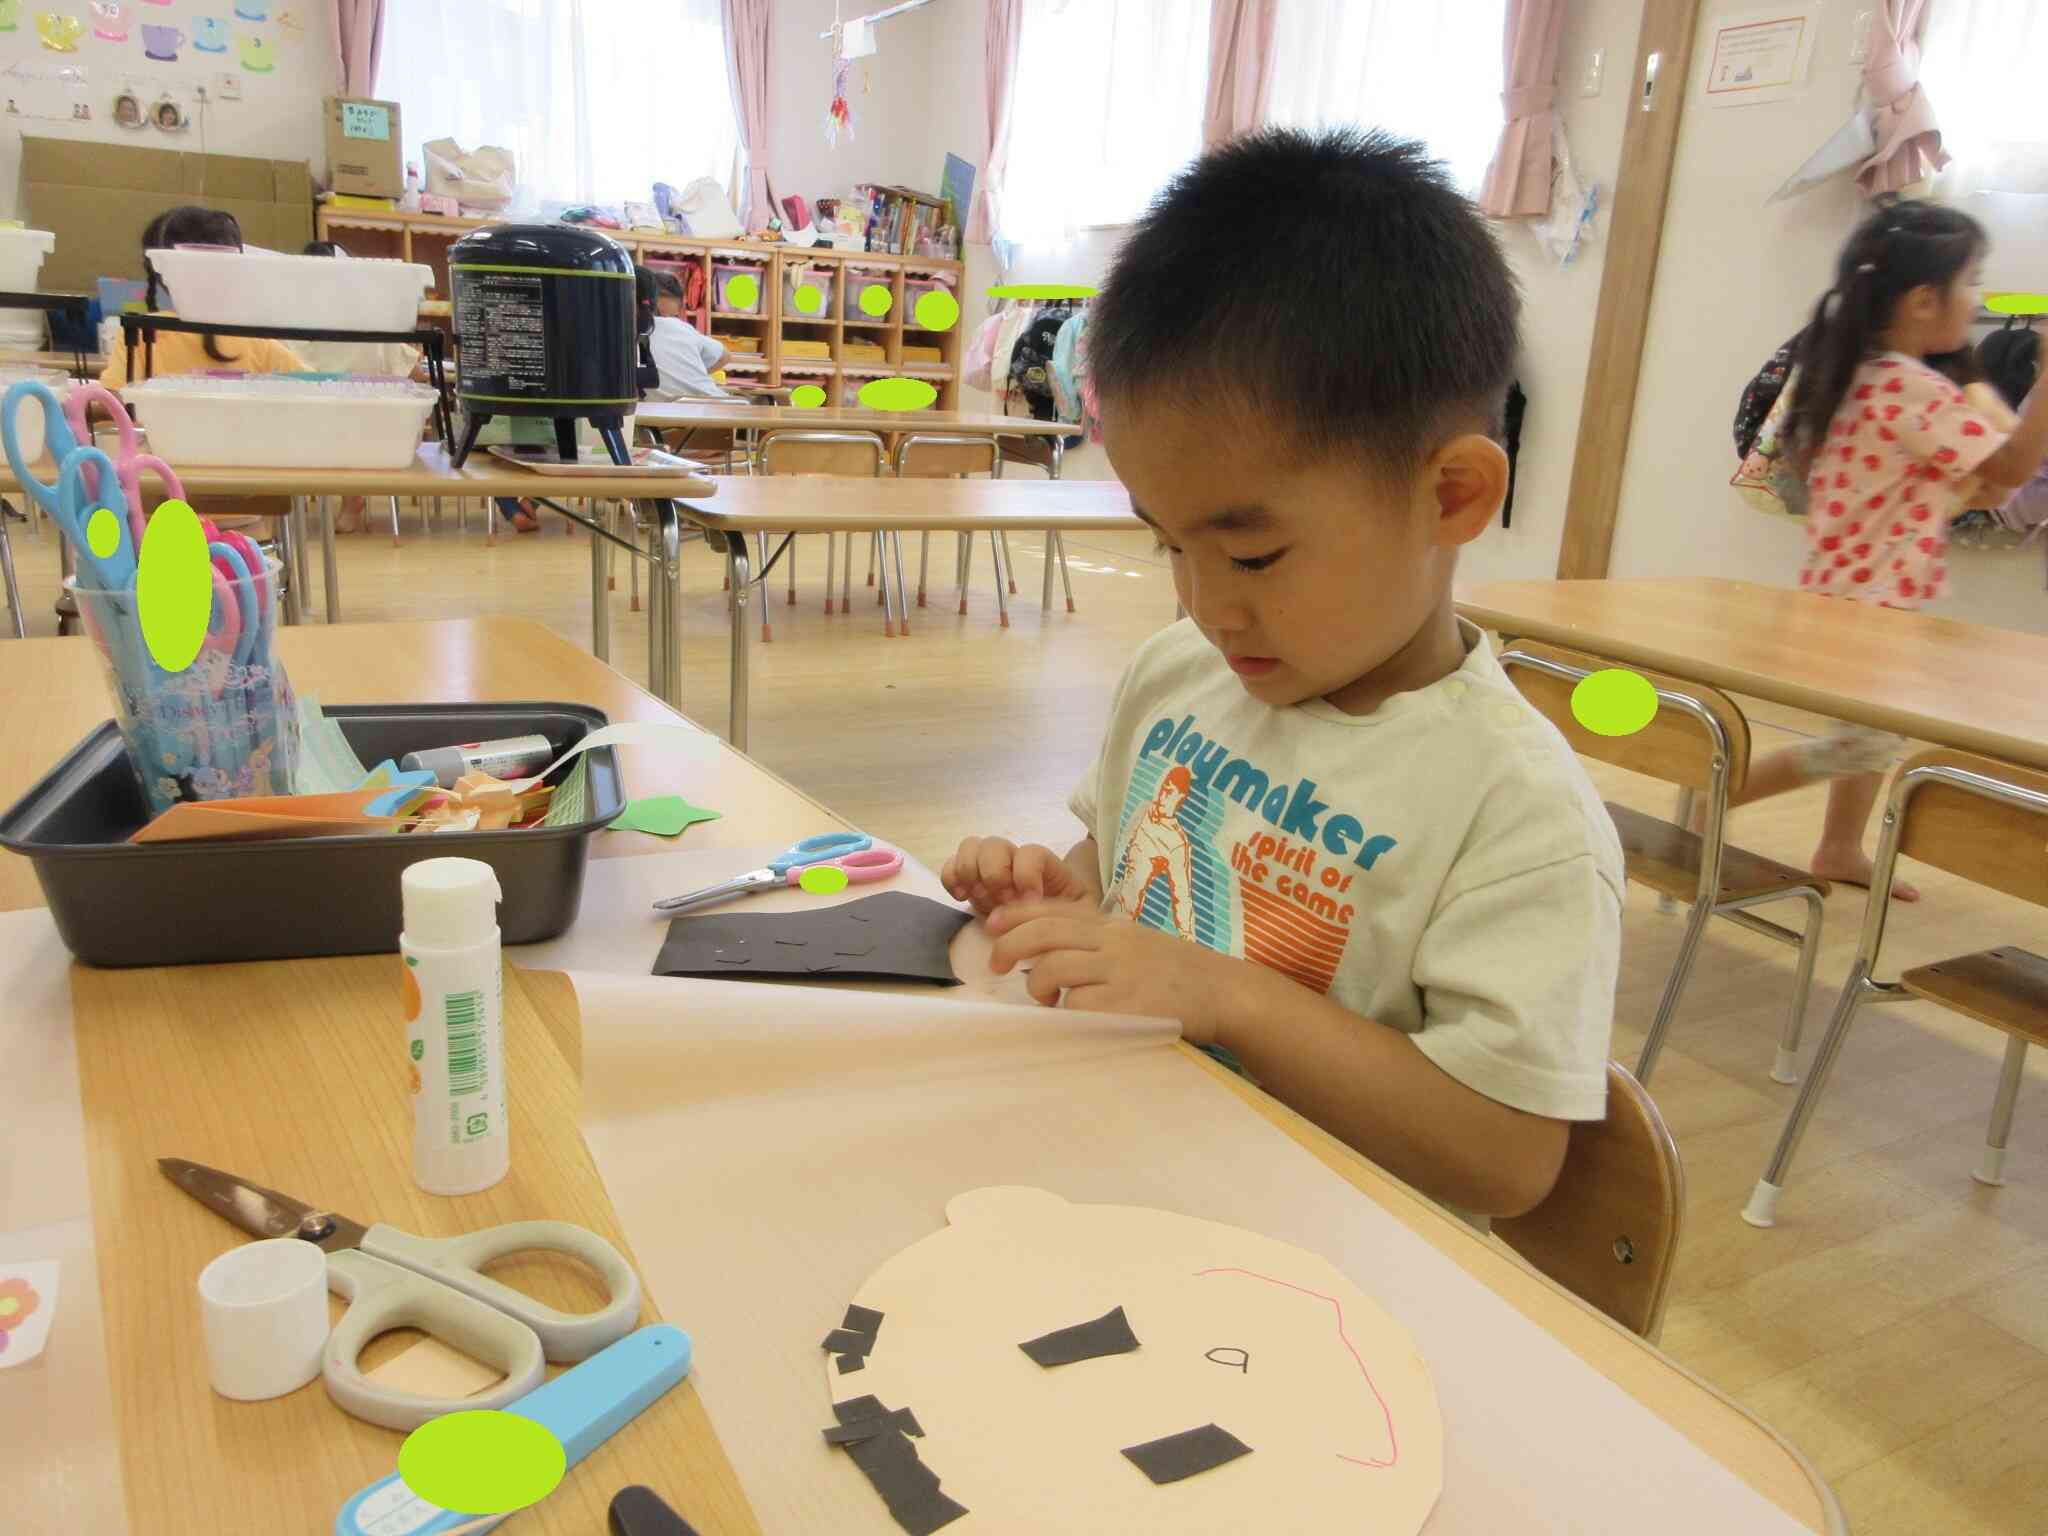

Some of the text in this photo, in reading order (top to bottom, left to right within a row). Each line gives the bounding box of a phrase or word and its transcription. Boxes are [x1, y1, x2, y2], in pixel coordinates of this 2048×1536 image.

[1139, 714, 1398, 871] playmaker
[1231, 842, 1269, 883] the
[1248, 831, 1354, 894] spirit of
